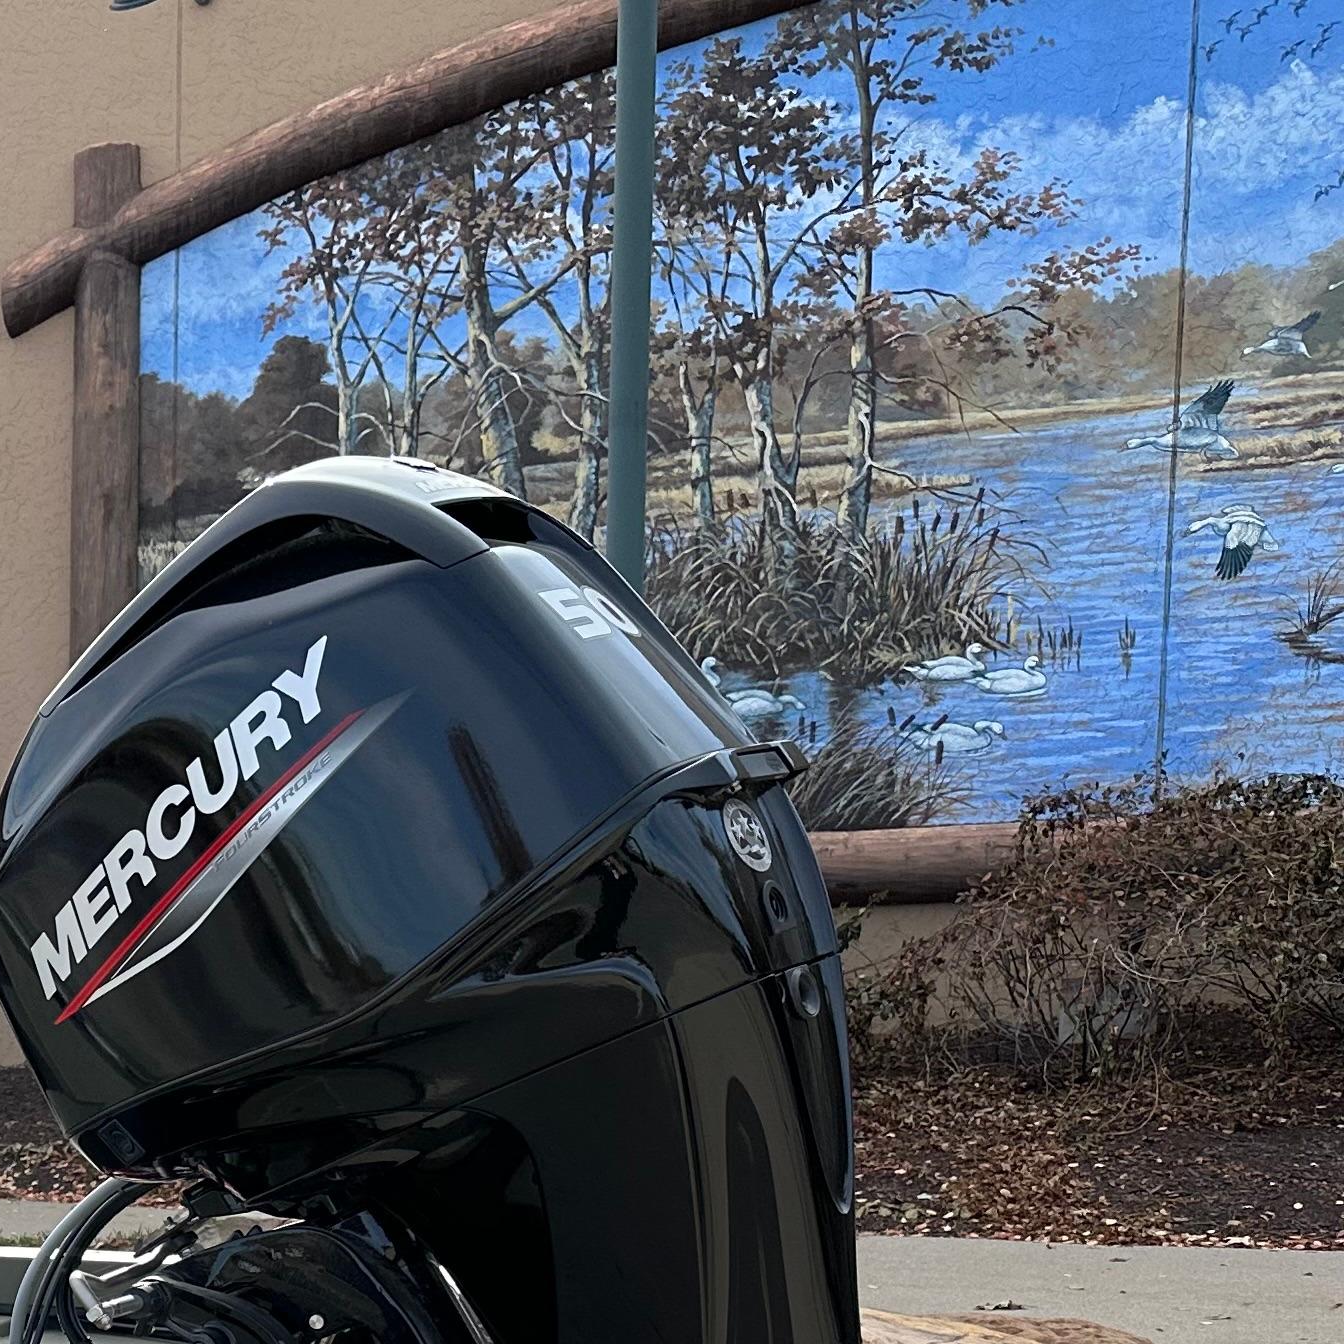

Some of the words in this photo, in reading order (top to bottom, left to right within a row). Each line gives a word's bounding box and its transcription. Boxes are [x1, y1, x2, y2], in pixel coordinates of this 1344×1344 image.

[537, 585, 642, 639] 50
[31, 635, 327, 1000] MERCURY
[213, 751, 331, 872] FOURSTROKE
